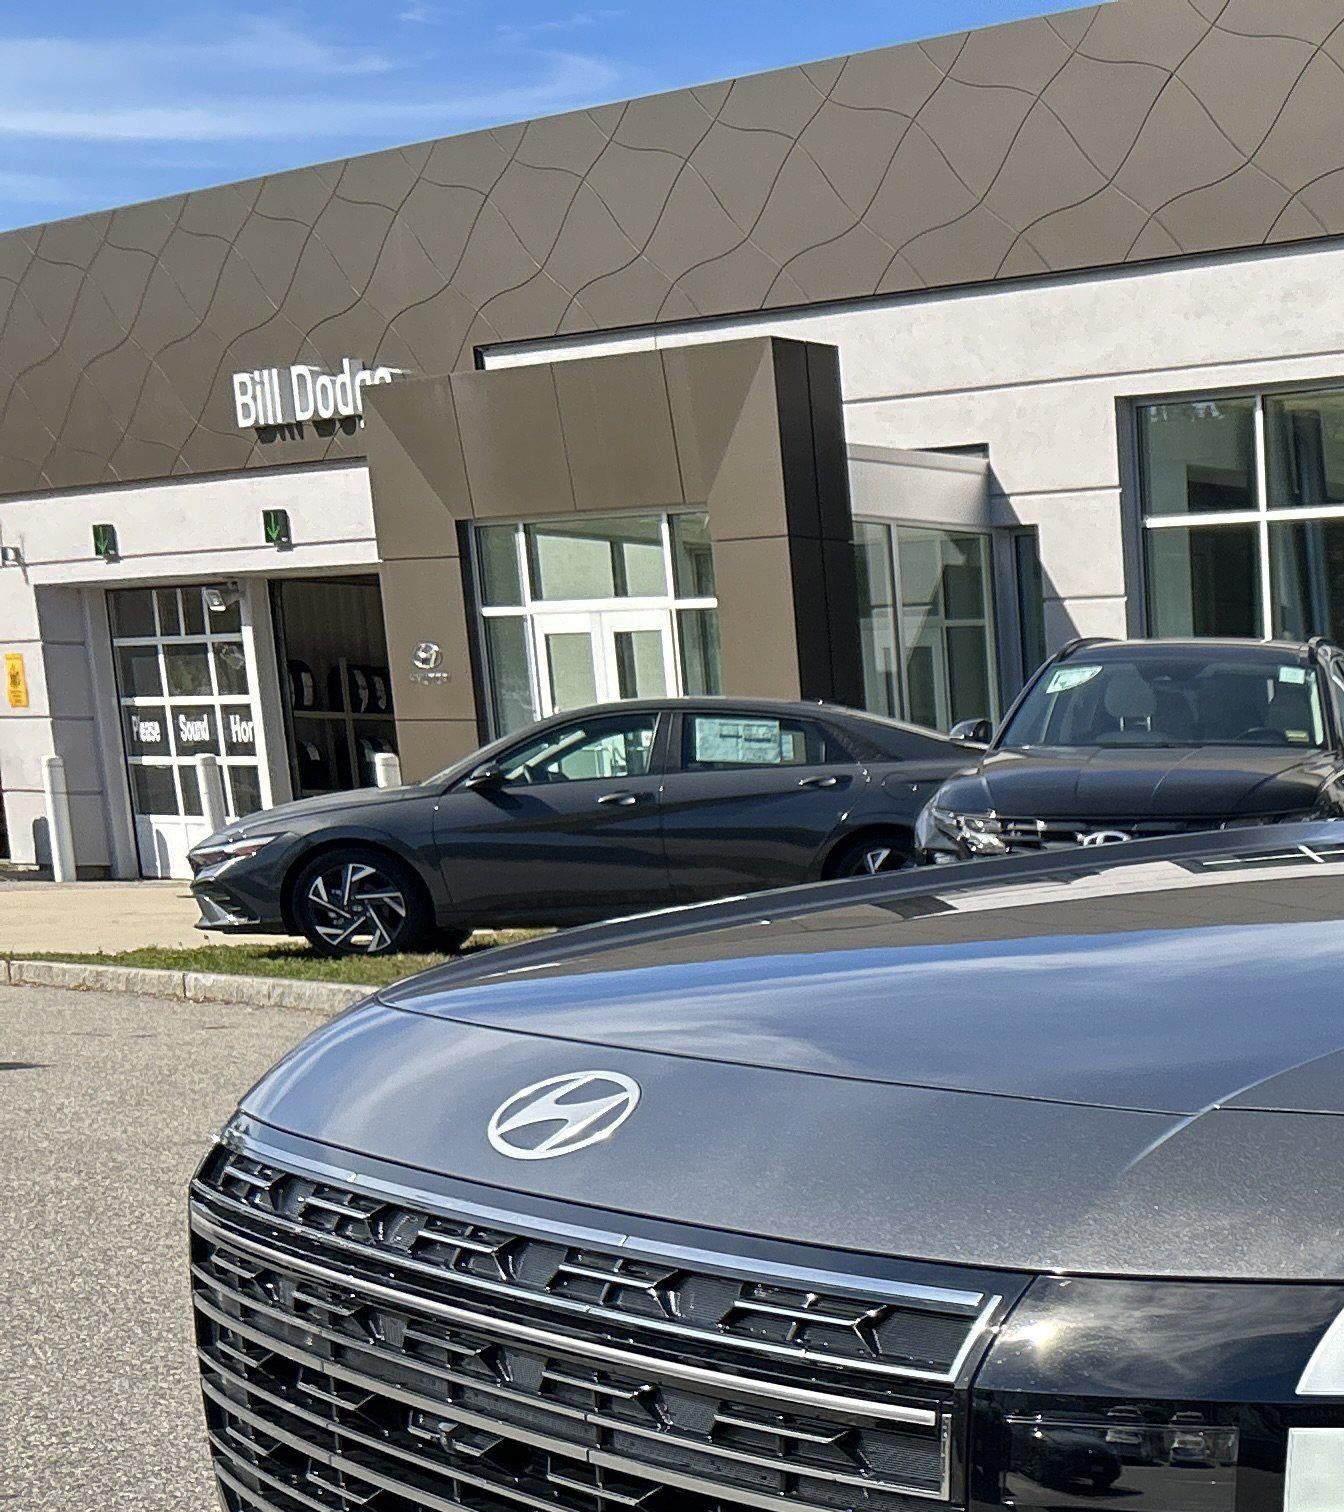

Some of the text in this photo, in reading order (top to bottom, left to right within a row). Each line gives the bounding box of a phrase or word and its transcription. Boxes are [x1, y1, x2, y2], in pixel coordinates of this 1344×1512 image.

[233, 358, 392, 429] Bill Dod
[178, 713, 210, 742] Sound
